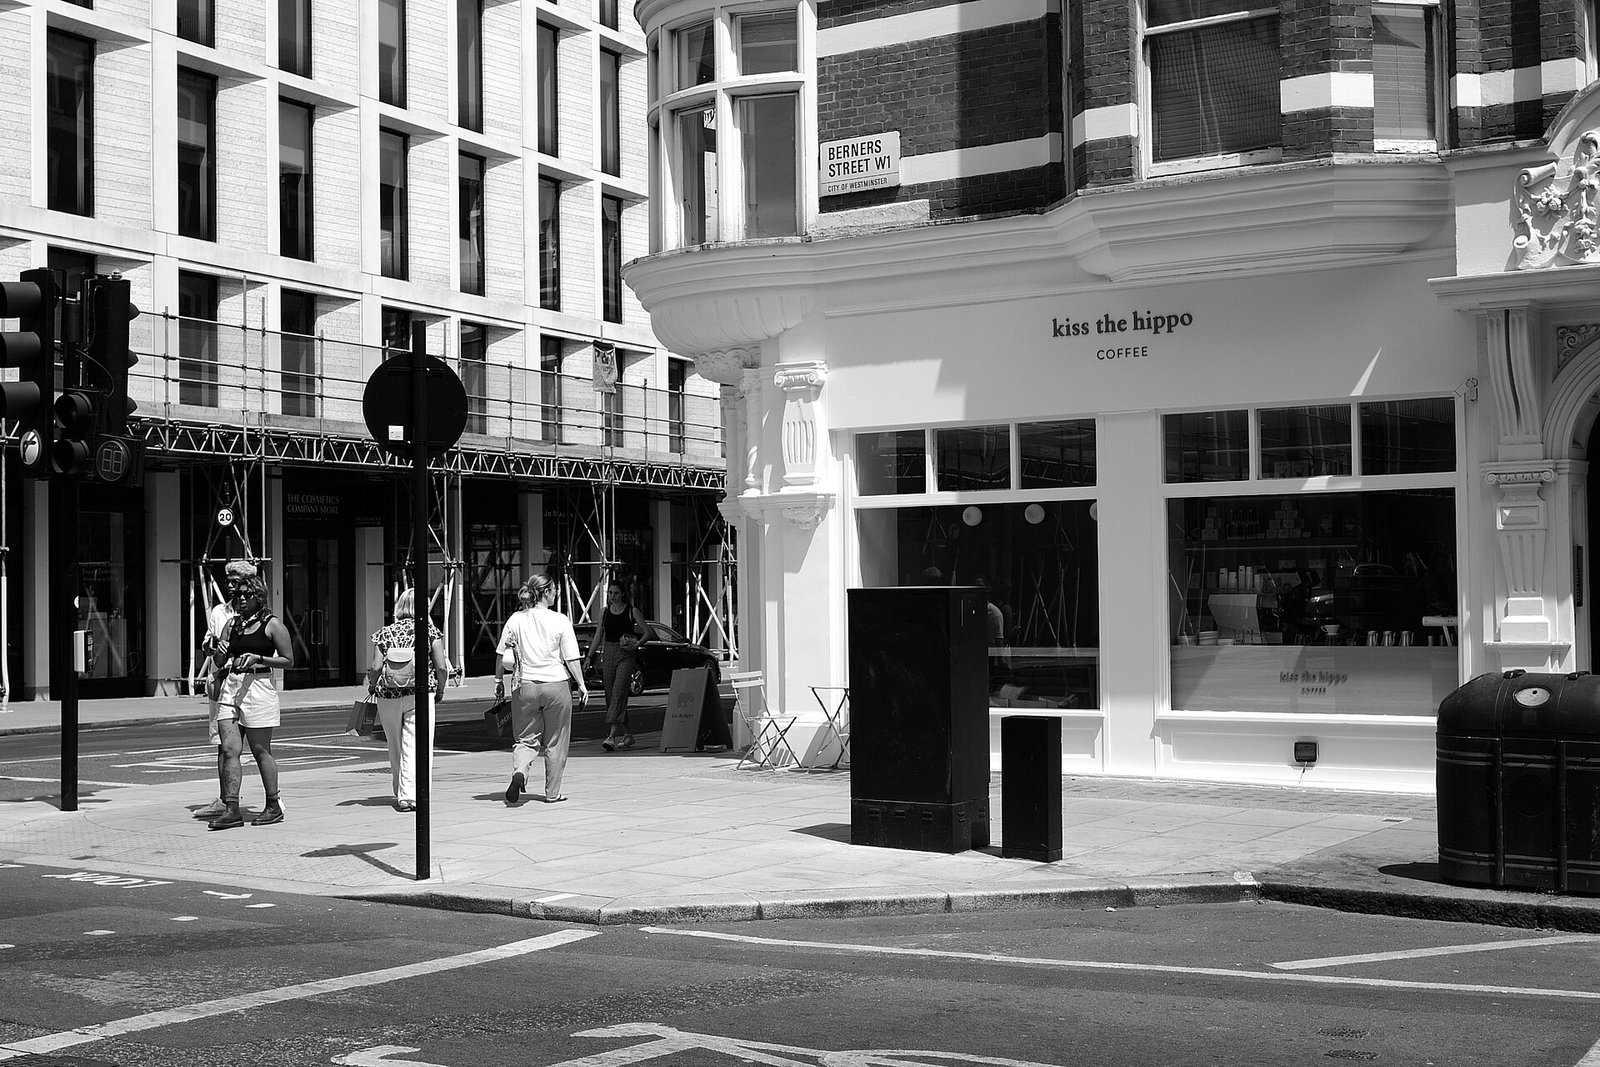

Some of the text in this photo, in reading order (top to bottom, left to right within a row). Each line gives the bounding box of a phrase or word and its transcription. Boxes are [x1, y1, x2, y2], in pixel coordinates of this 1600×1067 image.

[828, 139, 882, 161] BERNERS
[828, 155, 891, 178] STREET W1
[827, 177, 888, 193] CITY OF WESTMINSTER
[1051, 310, 1194, 338] kiss the hippo
[1096, 346, 1149, 360] COFFEE
[287, 493, 340, 505] THE COSMETICS
[286, 504, 320, 514] COMPANY
[219, 513, 232, 522] 20
